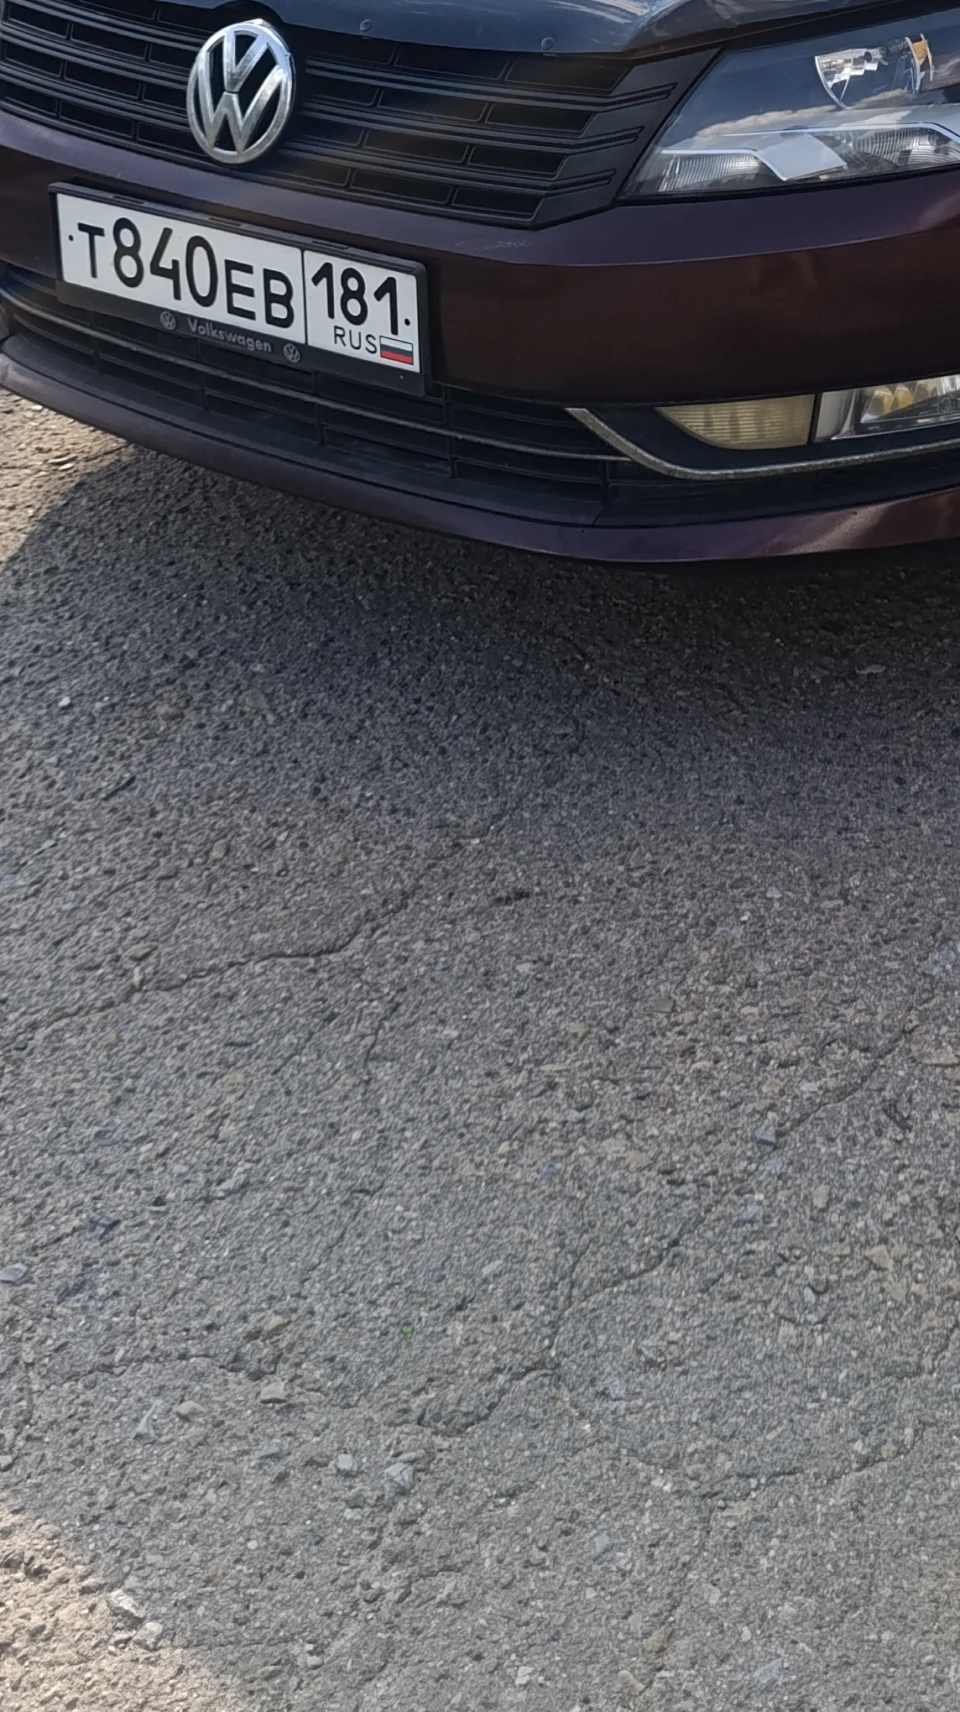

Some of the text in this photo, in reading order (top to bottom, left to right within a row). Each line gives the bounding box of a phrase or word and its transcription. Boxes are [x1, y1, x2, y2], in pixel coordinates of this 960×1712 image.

[311, 262, 399, 336] 181
[187, 317, 272, 353] Volkswagen
[333, 325, 378, 355] RUS
